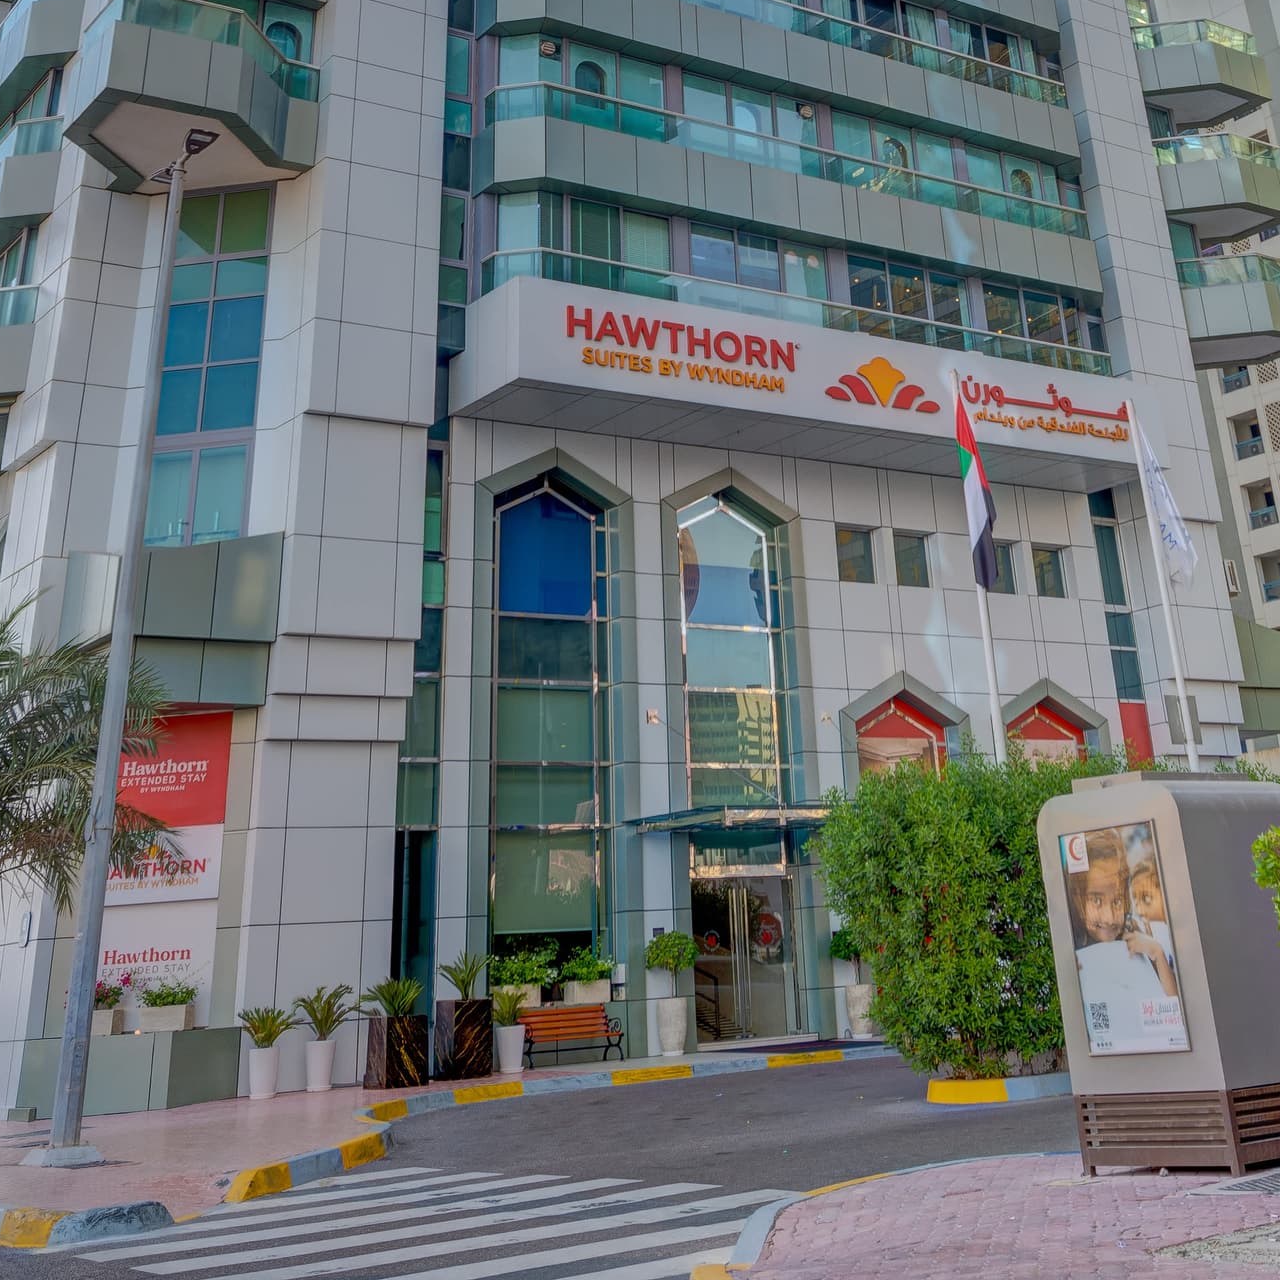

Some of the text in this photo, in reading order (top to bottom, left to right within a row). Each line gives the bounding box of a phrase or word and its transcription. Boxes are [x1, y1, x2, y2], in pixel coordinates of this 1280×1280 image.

[566, 305, 796, 372] HAWTHORN
[582, 346, 786, 393] SUITES BY WYNDHAM
[122, 758, 209, 777] Hawthorn
[120, 772, 208, 788] EXTENDED STAY
[140, 785, 185, 794] BY WYNDHAM
[107, 858, 207, 880] AWTHORN
[103, 947, 191, 966] Hawthorn
[101, 963, 191, 978] EXTENDED STAY
